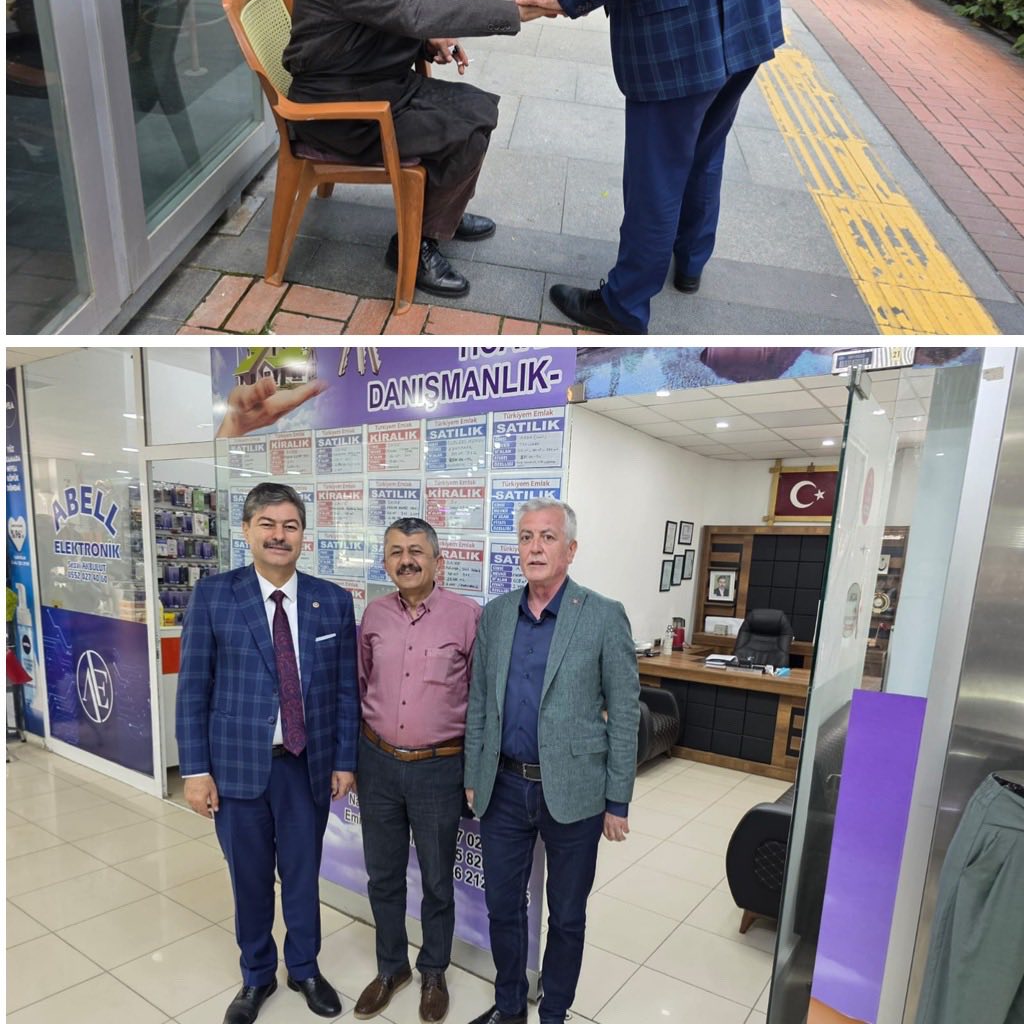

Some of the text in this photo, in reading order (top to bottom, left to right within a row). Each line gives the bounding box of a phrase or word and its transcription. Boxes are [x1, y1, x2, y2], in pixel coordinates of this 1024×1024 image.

[496, 419, 560, 434] SATILIK
[370, 429, 417, 443] KİRALIK
[430, 426, 483, 440] SATILIK
[271, 439, 310, 449] KİRALIK
[318, 436, 360, 447] SATILIK
[231, 444, 265, 453] SATILIK
[233, 494, 247, 502] SAT
[318, 490, 360, 500] KİRALIK
[371, 488, 417, 499] SATILIK
[428, 487, 482, 498] KİRALIK
[495, 489, 556, 500] SATILIK
[52, 484, 119, 538] ABELL
[320, 540, 362, 550] SATILIK
[441, 550, 481, 560] RALIK
[494, 555, 520, 564] SAT
[466, 852, 483, 868] 82
